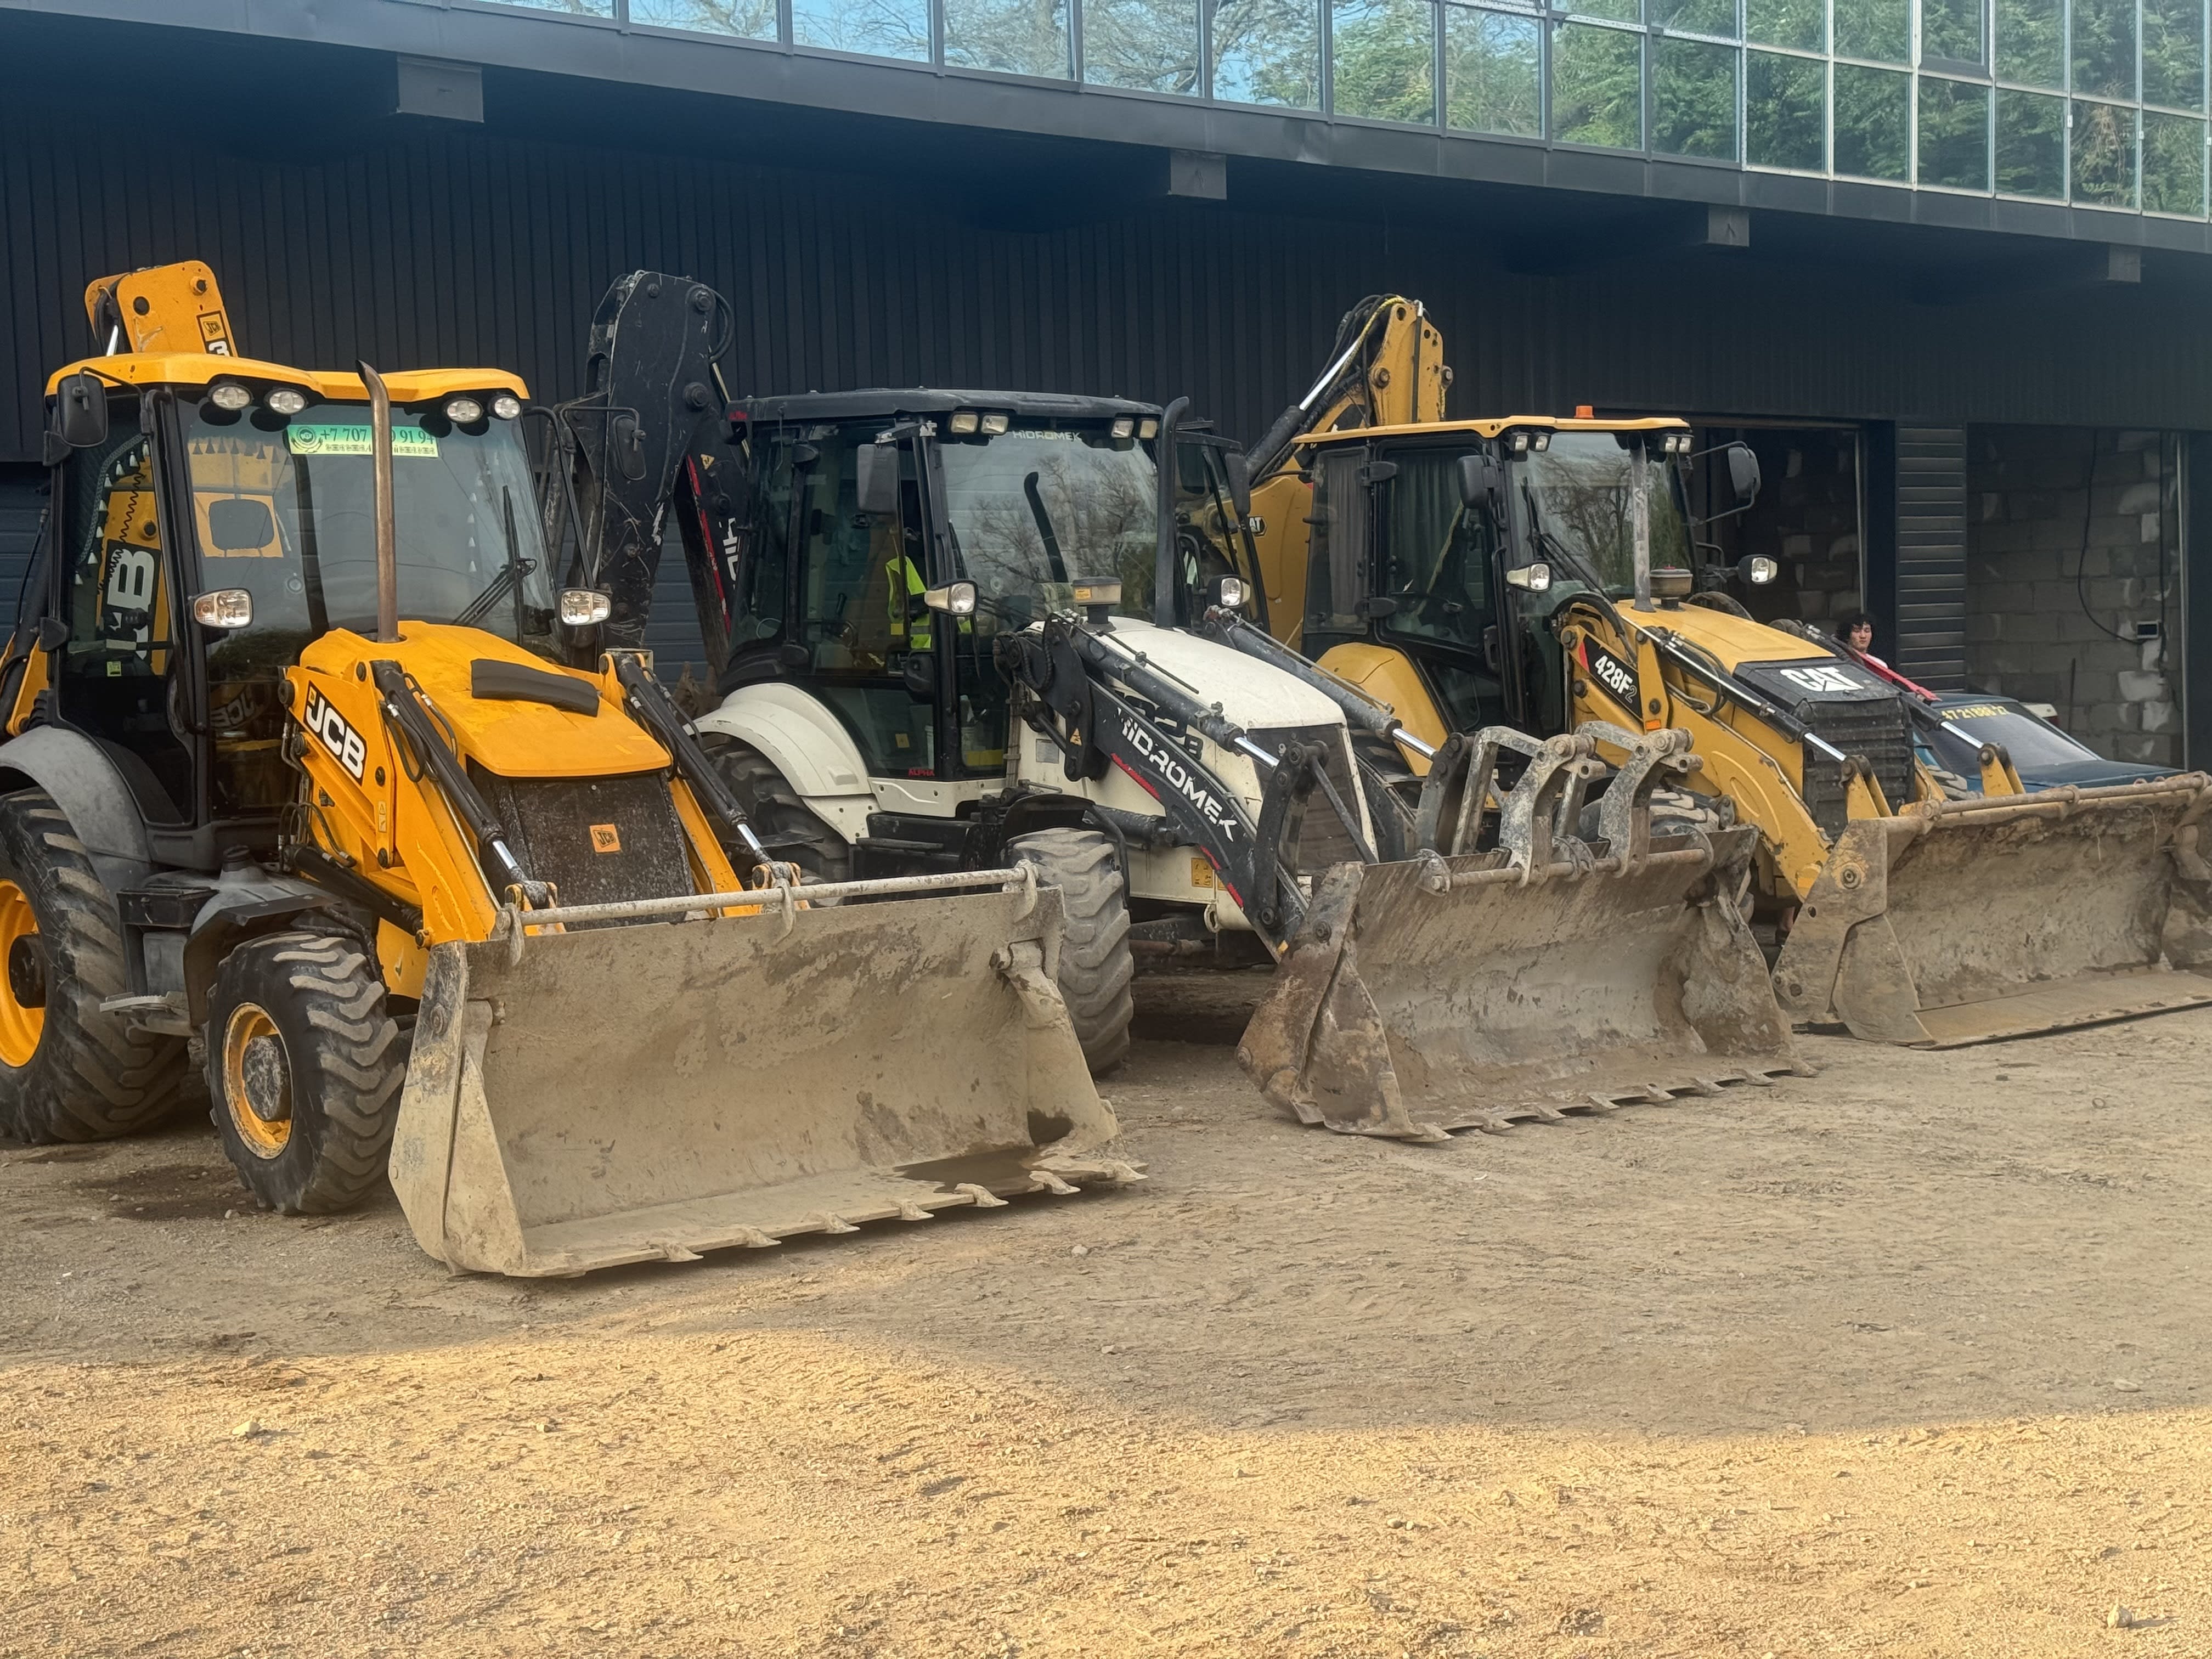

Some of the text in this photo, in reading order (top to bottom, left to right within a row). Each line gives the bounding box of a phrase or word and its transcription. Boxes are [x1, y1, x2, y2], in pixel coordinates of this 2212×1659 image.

[320, 428, 337, 441] +7
[343, 428, 367, 442] 707
[399, 430, 415, 443] 91
[1595, 655, 1638, 704] 428F2
[1780, 667, 1865, 692] CAT
[306, 697, 365, 778] JCB
[596, 831, 615, 845] JCB
